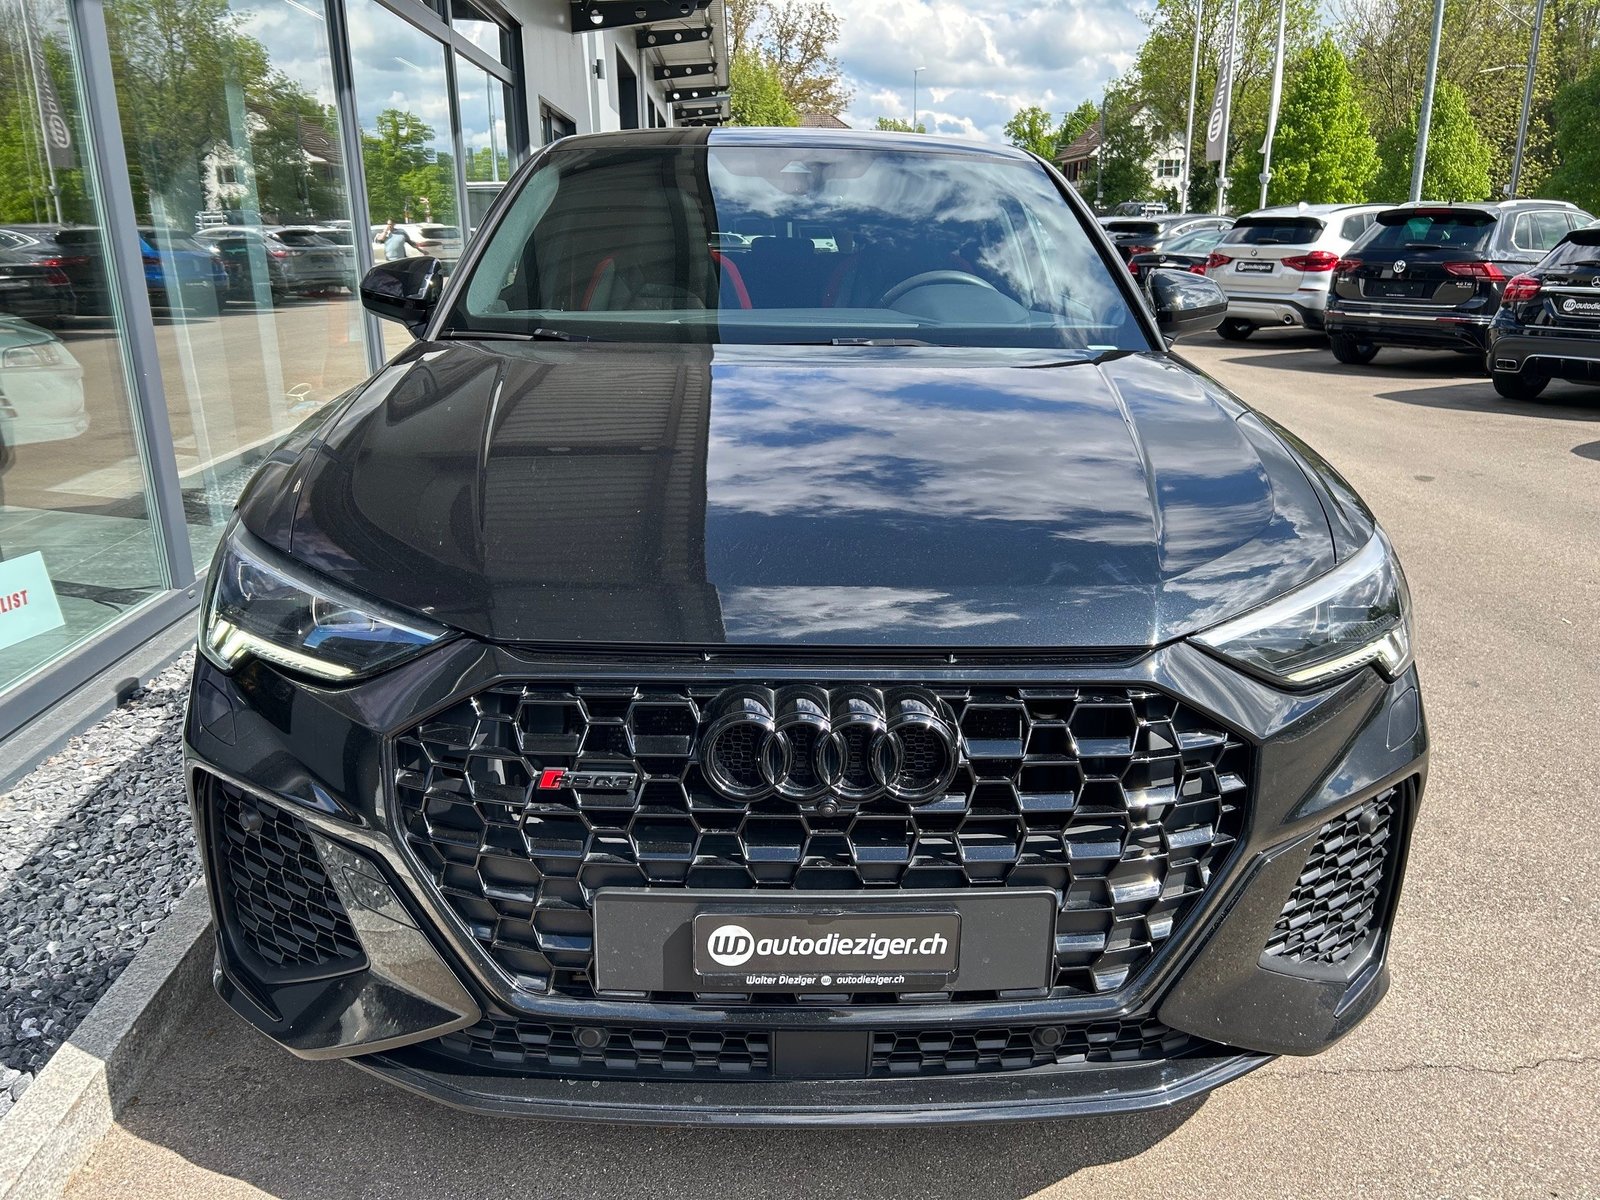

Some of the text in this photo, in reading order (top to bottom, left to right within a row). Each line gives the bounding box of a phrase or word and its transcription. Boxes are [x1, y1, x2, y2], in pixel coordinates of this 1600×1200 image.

[0, 589, 28, 613] LIST
[756, 932, 948, 960] autodieziger.ch
[746, 975, 777, 985] Walter
[778, 975, 816, 986] Dieziger
[836, 975, 905, 986] autodieziger.ch
